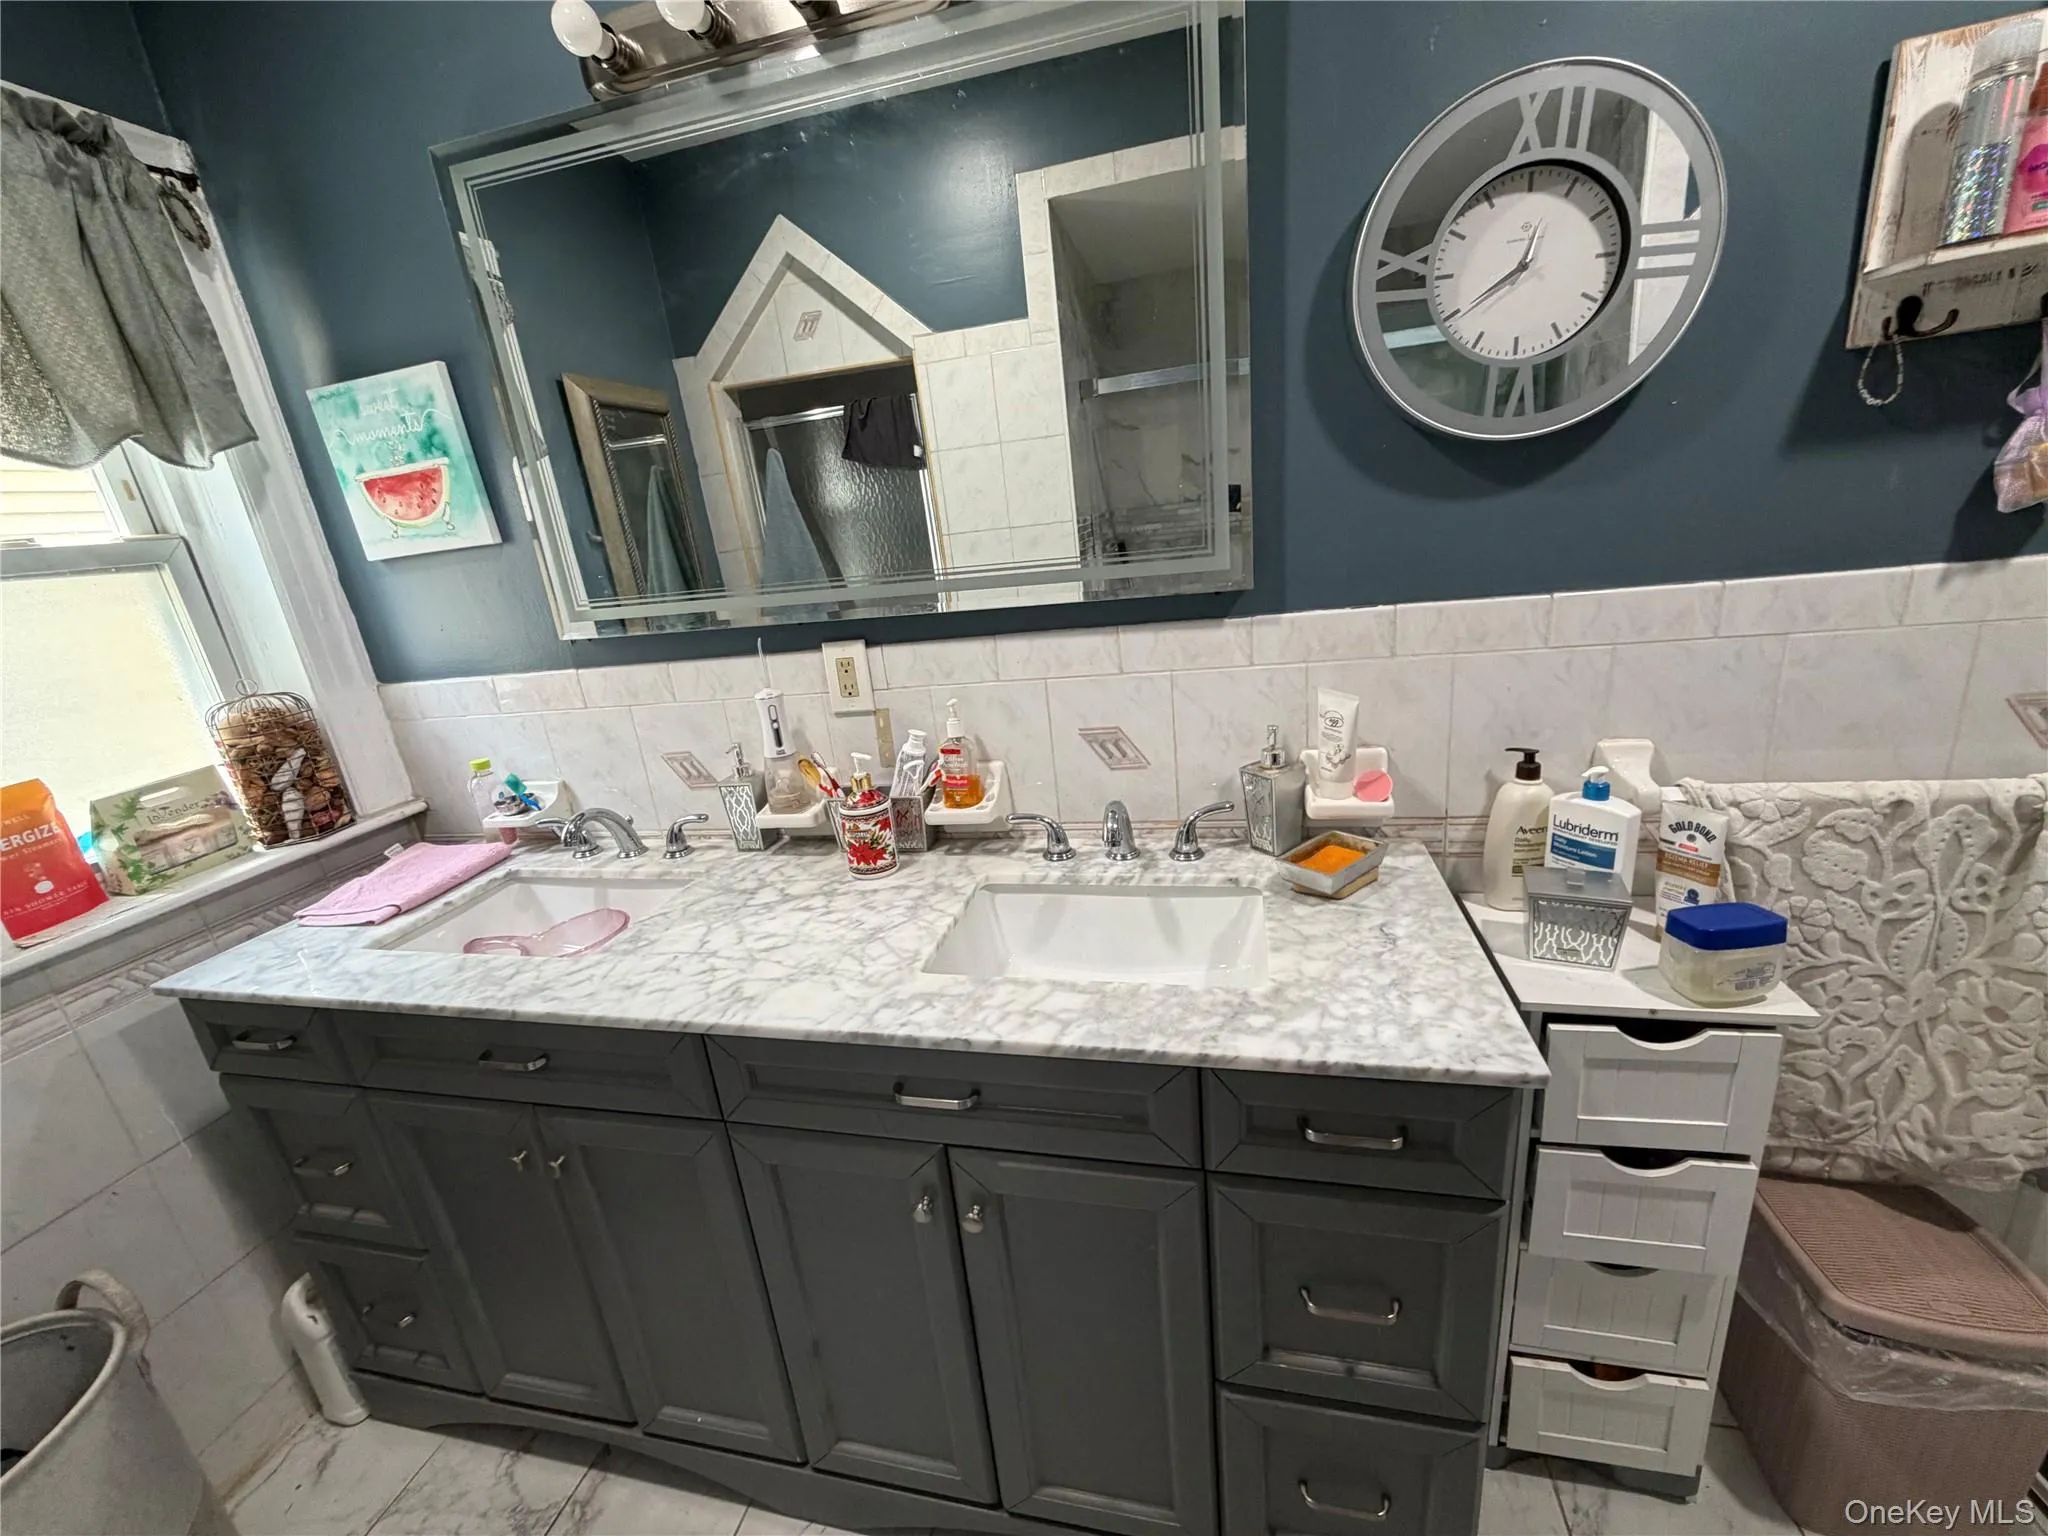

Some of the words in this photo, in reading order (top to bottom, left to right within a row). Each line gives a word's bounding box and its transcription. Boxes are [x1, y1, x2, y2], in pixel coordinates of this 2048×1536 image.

[1506, 86, 1597, 161] XII
[1634, 220, 1701, 280] III
[1374, 242, 1434, 302] IX
[340, 409, 430, 447] moments
[1516, 825, 1548, 835] Aveen
[1552, 813, 1620, 843] Lubriderm
[1668, 820, 1694, 835] GOLD
[1694, 822, 1718, 844] BOND
